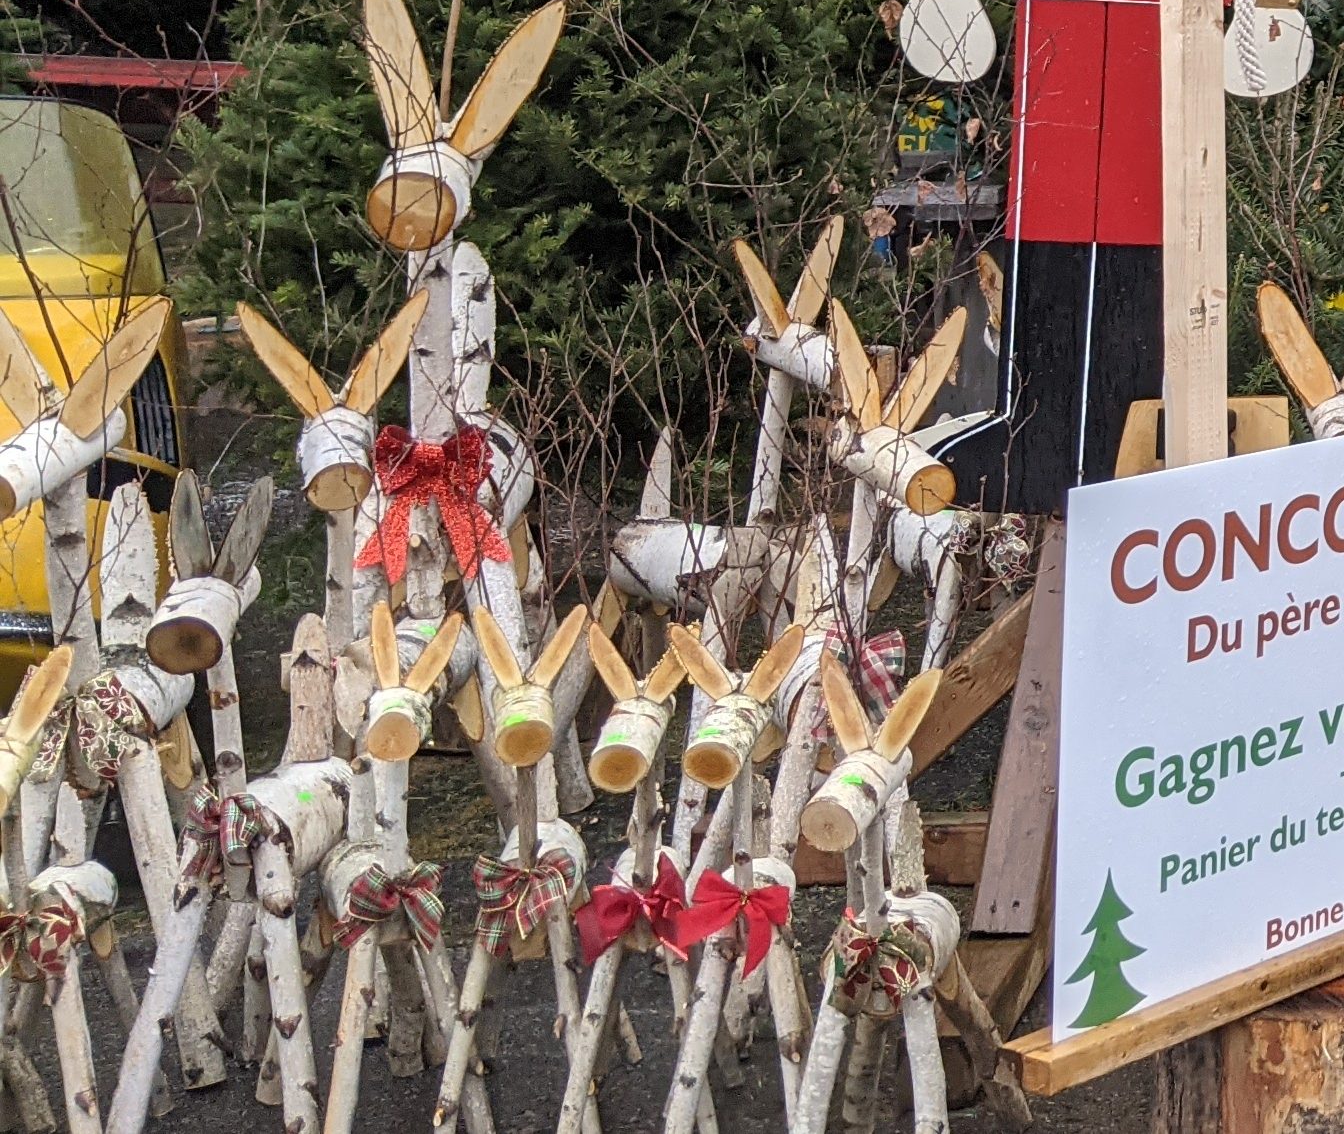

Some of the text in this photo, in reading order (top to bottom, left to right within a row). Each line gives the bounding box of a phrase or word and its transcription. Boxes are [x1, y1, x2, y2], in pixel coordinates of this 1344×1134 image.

[1186, 614, 1242, 664] Du
[1256, 593, 1340, 657] père
[1115, 716, 1304, 808] Gagnez
[1159, 829, 1262, 893] Panier
[1270, 812, 1307, 853] du
[1266, 896, 1344, 951] Bonne
